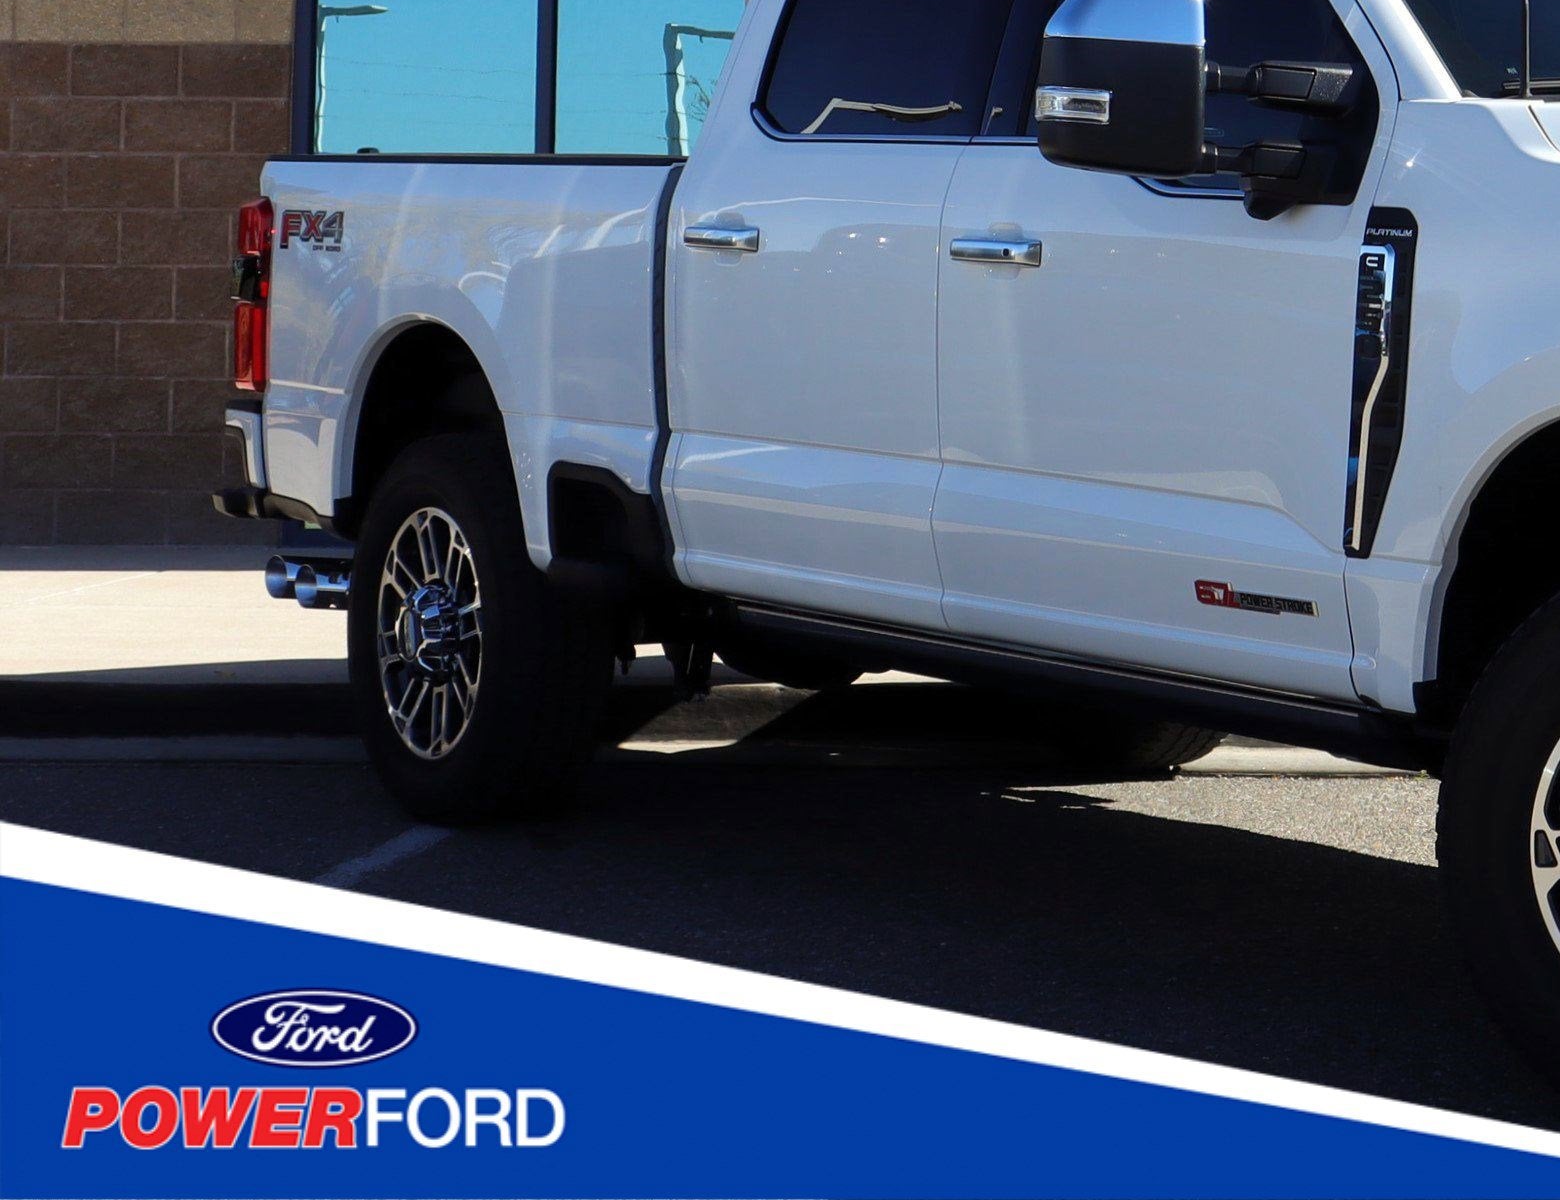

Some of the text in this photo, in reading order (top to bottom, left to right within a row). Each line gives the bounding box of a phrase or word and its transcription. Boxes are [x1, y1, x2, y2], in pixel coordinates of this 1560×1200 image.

[280, 209, 344, 249] FX4
[1366, 227, 1413, 237] PLATINUM
[1240, 593, 1273, 609] POWER
[1275, 597, 1314, 615] STROKE
